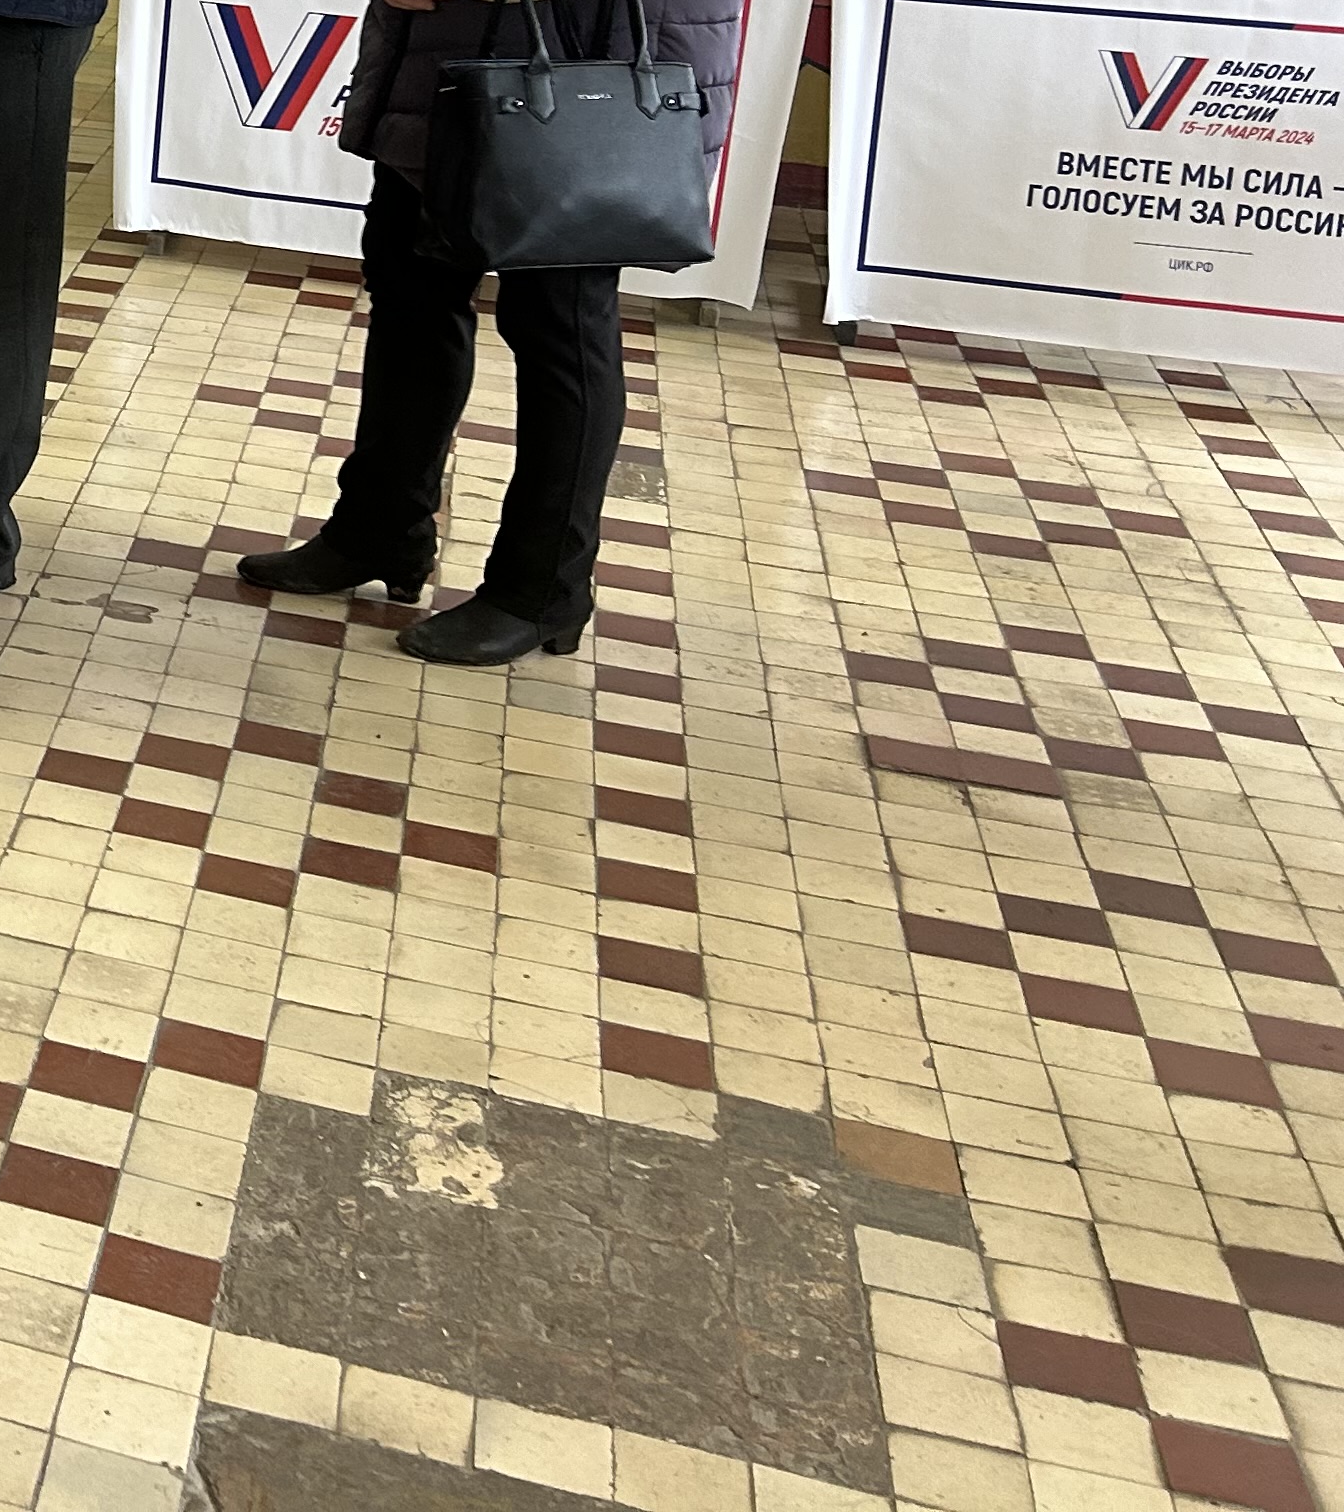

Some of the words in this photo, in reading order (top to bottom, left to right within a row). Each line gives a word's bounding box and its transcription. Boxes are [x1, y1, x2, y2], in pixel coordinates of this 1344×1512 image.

[1216, 60, 1316, 82] ВЫБОРЫ
[1203, 81, 1341, 106] ПРЕЗИДЕНТА
[1189, 101, 1279, 122] РОССИИ
[1221, 124, 1276, 142] МАРТА
[1276, 129, 1315, 145] 2024
[1057, 151, 1172, 185] ВМЕСТЕ
[1180, 163, 1234, 190] МЫ
[1243, 168, 1323, 199] СИЛА
[1026, 184, 1181, 221] ГОЛОСУЕМ
[1190, 200, 1225, 226] ЗА
[1169, 258, 1214, 272] ЦИК.РФ
